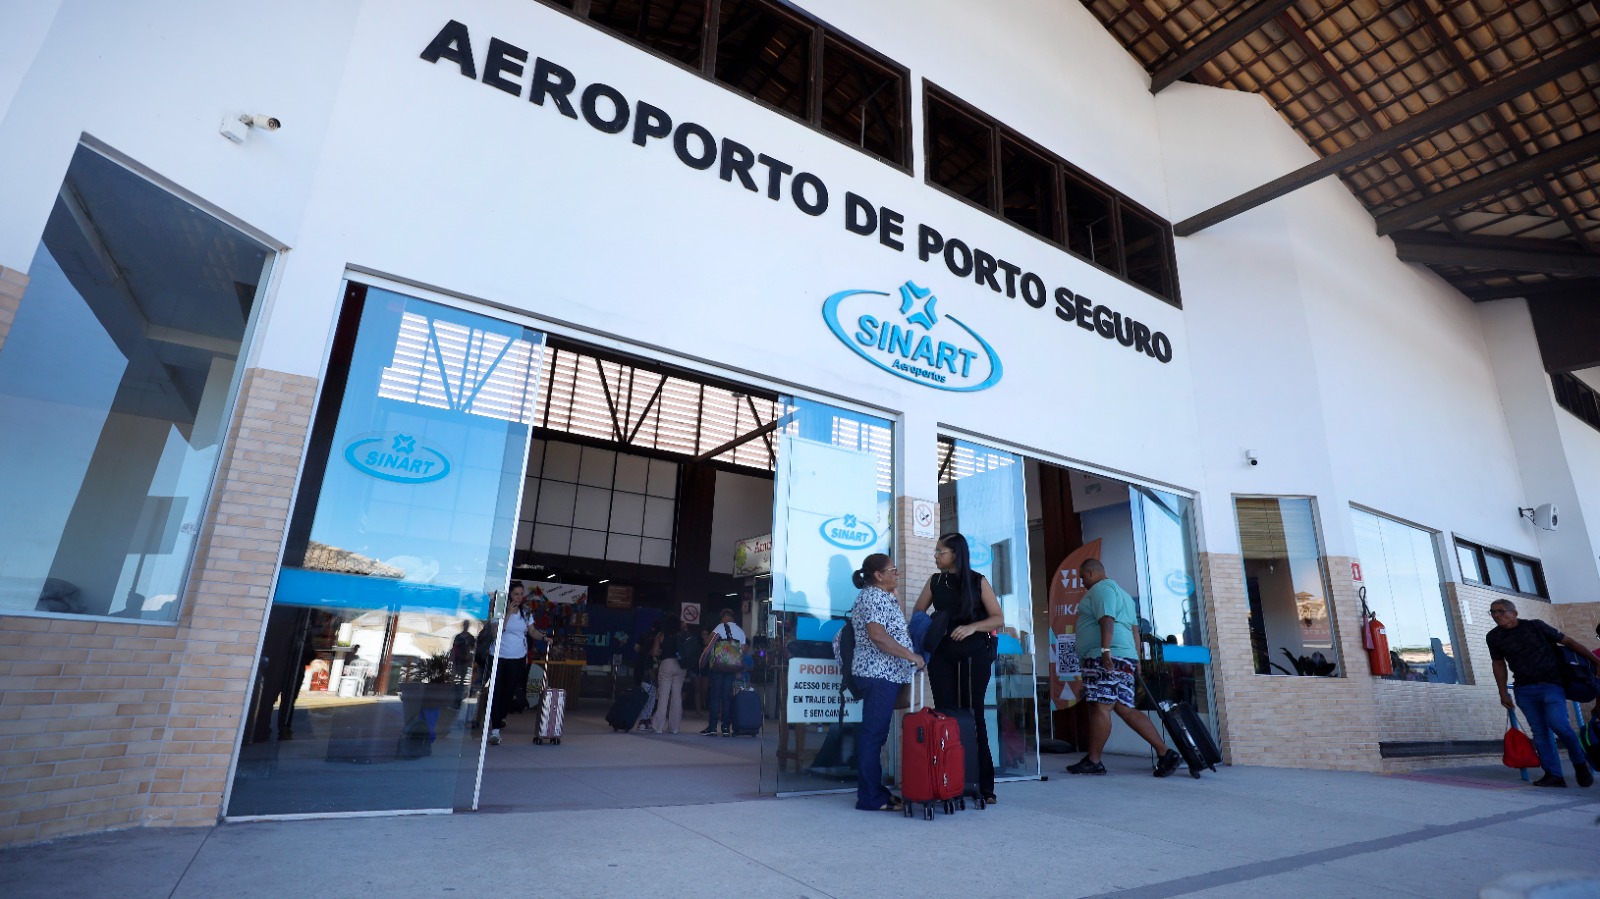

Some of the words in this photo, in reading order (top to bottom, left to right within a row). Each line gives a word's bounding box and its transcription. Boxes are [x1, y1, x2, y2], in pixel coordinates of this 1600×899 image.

[420, 19, 829, 216] AEROPORTO
[845, 191, 905, 251] DE
[918, 223, 1047, 309] PORTO
[1054, 287, 1172, 364] SEGURO
[855, 315, 978, 378] SINART
[892, 358, 946, 383] Aeroportos
[365, 451, 435, 475] SINART
[831, 528, 869, 542] SINART
[799, 664, 842, 675] PROIBI
[794, 682, 820, 690] ACESSO
[822, 682, 831, 690] DE
[793, 695, 804, 704] EM
[805, 695, 826, 704] TRAJE
[828, 696, 837, 704] DE
[804, 709, 808, 717] E
[810, 709, 823, 717] SEM
[825, 709, 849, 718] CAMA
